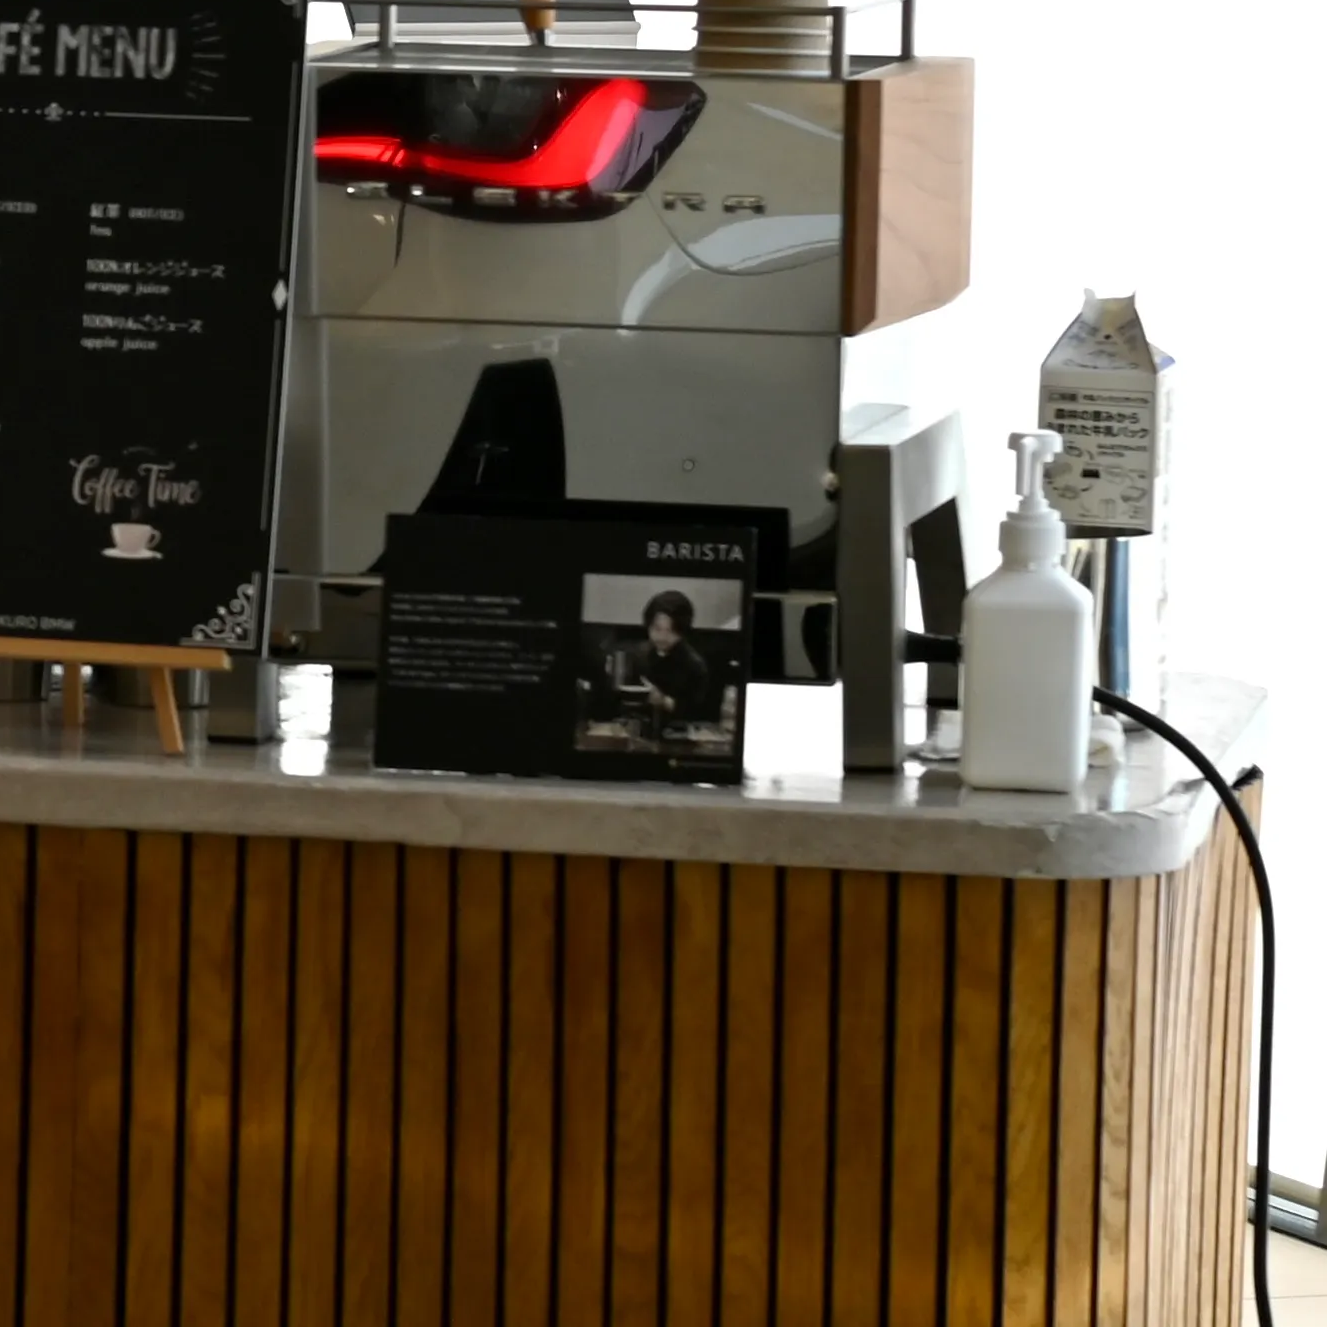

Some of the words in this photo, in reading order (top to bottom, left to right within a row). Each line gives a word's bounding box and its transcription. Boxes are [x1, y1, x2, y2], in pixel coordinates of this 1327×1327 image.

[55, 24, 176, 80] MENU
[84, 282, 131, 296] orange
[135, 283, 171, 296] juice
[80, 336, 118, 349] apple
[122, 338, 158, 352] juice
[69, 454, 137, 513] Coffee
[138, 463, 201, 508] Time
[646, 540, 744, 562] BARISTA
